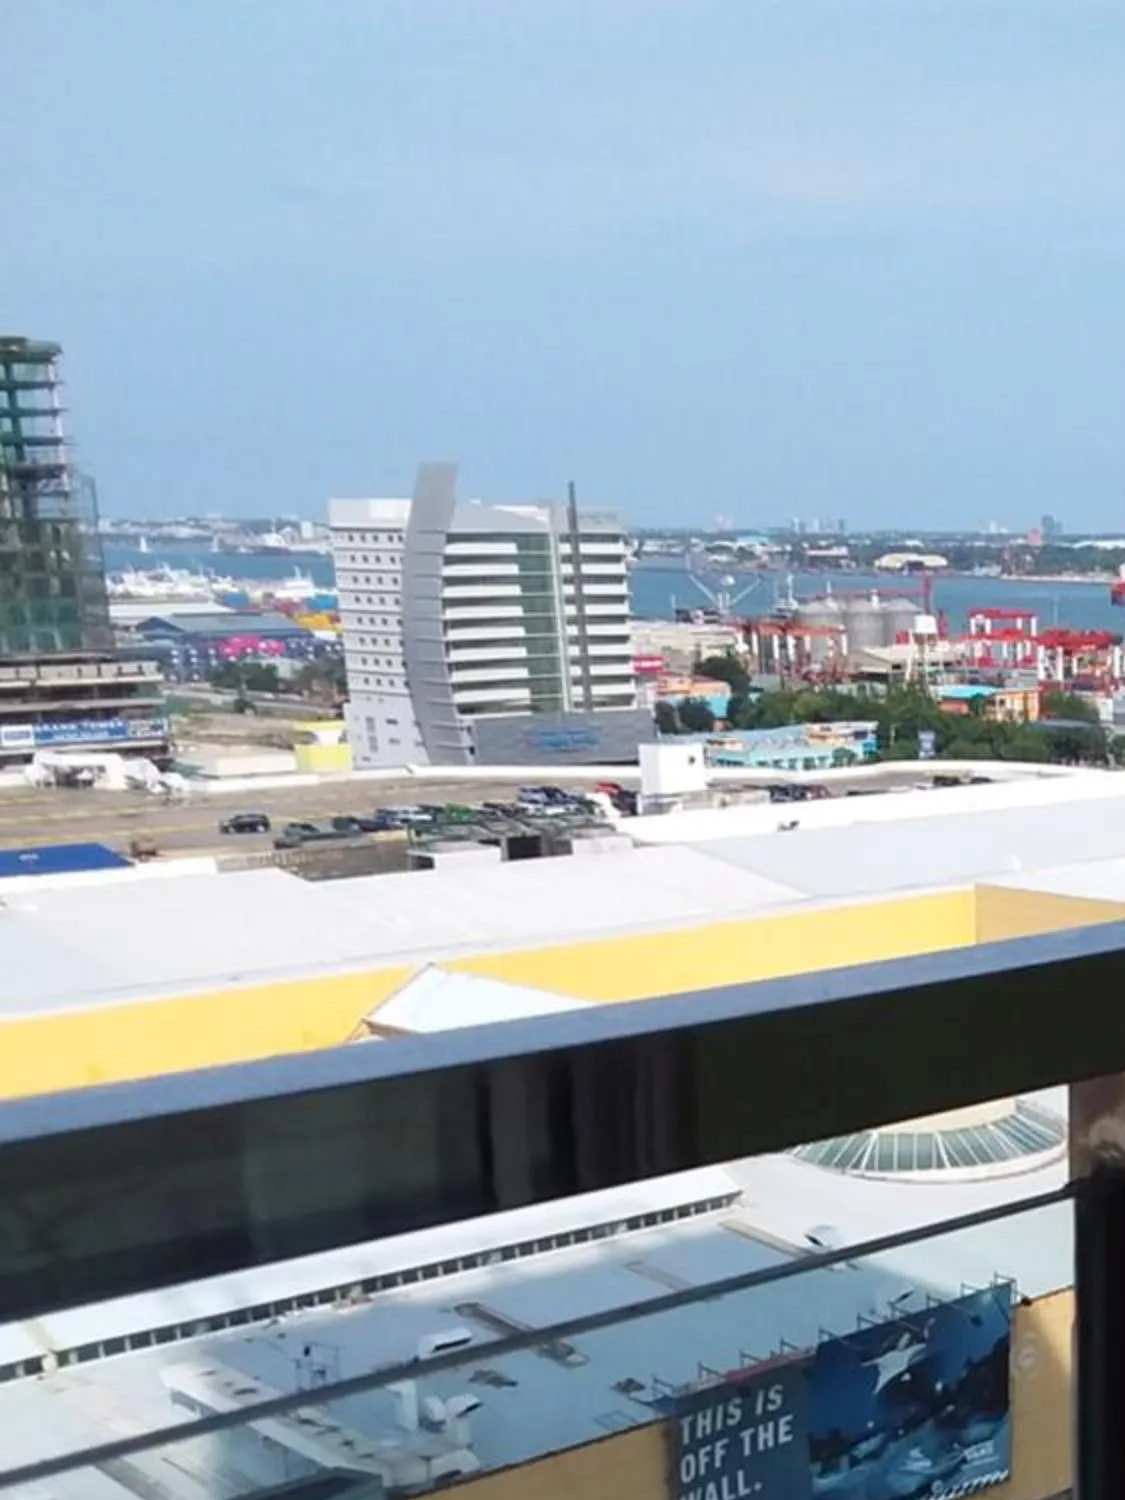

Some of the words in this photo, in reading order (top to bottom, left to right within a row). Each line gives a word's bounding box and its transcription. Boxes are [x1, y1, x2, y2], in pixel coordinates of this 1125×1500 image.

[680, 1397, 743, 1446] THIS
[755, 1384, 784, 1415] IS
[679, 1438, 730, 1484] OFF
[739, 1414, 794, 1457] THE
